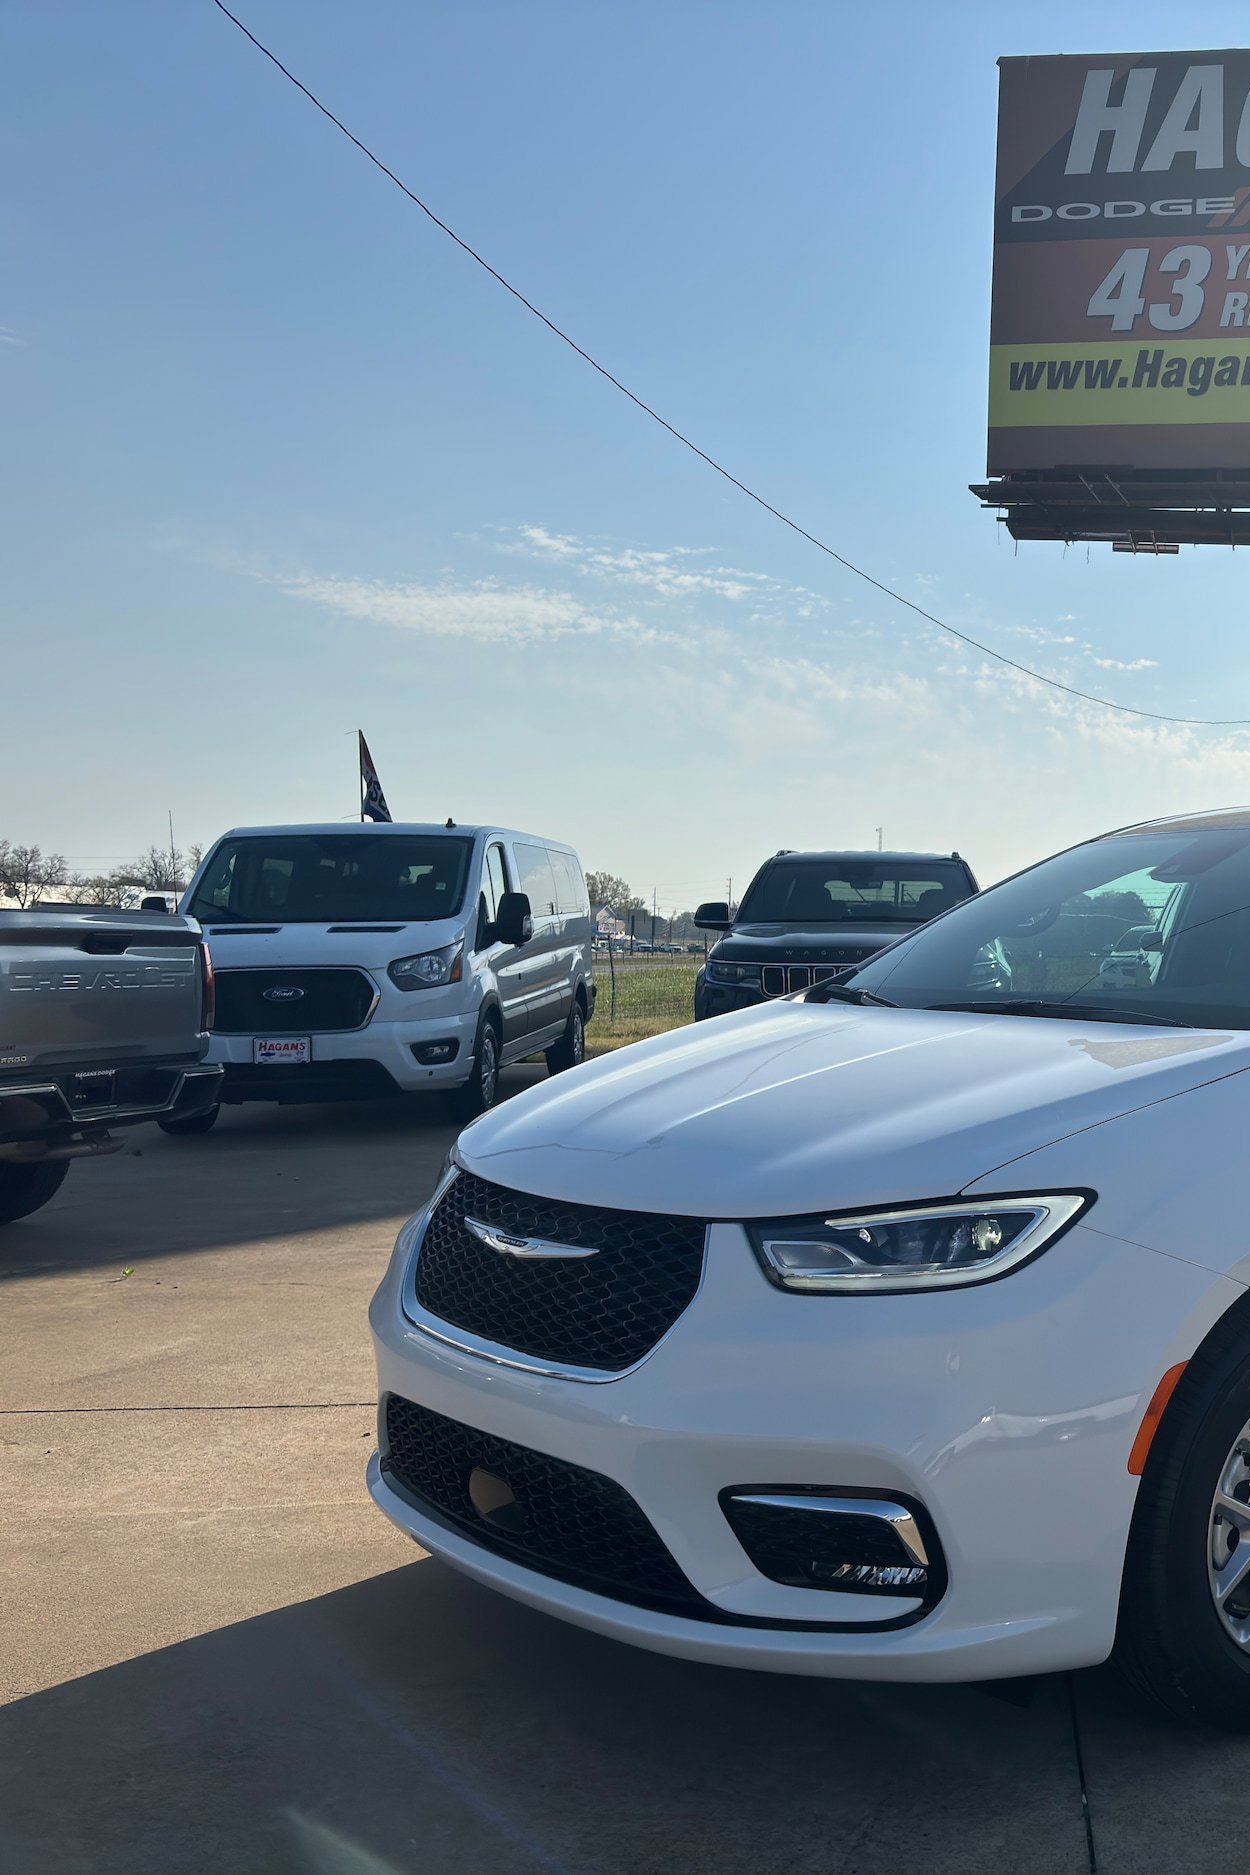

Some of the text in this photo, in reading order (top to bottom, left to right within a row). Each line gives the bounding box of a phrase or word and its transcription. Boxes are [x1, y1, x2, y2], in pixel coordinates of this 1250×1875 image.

[1011, 195, 1236, 223] DODGE
[1086, 245, 1213, 333] 43
[785, 949, 863, 957] WAGON
[271, 988, 294, 998] Ford
[258, 1041, 306, 1052] HAGANS
[498, 1237, 525, 1246] CHRYSLER
